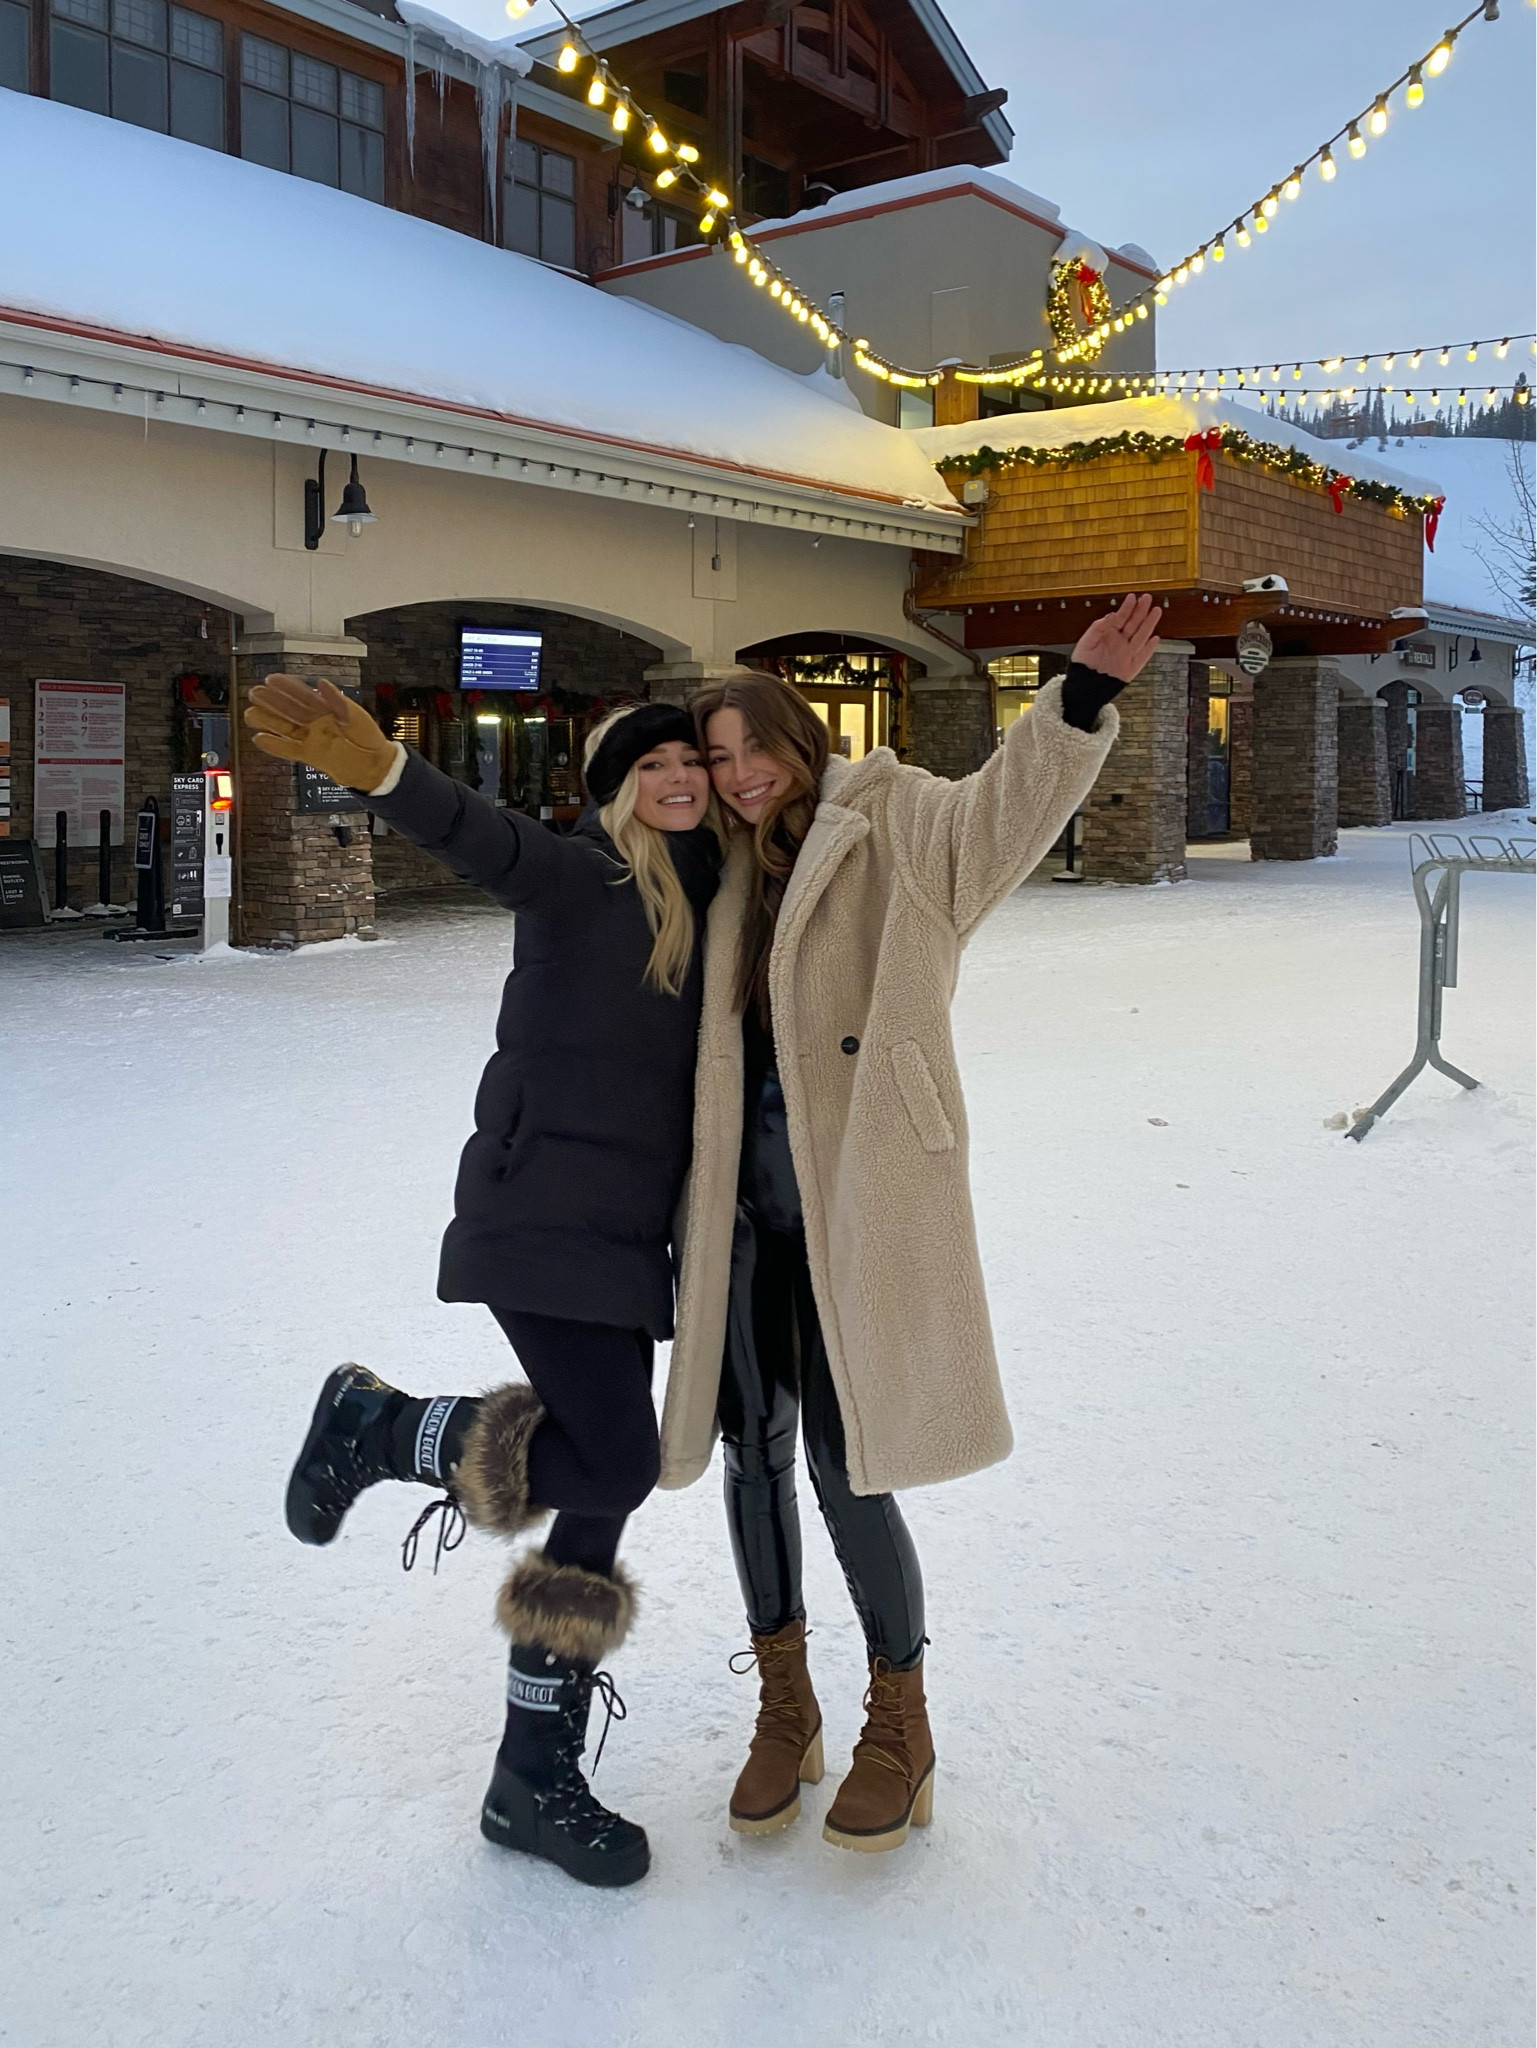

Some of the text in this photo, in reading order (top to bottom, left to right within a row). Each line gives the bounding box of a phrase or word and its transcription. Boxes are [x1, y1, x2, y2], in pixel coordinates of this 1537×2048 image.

[1414, 652, 1433, 665] RENTALS
[82, 698, 88, 709] 5
[38, 711, 44, 721] 2
[81, 712, 88, 722] 6
[38, 726, 44, 736] 3
[81, 726, 88, 736] 7
[37, 739, 44, 750] 4
[421, 1401, 449, 1469] MOON BOOT
[525, 1683, 555, 1704] BOOT
